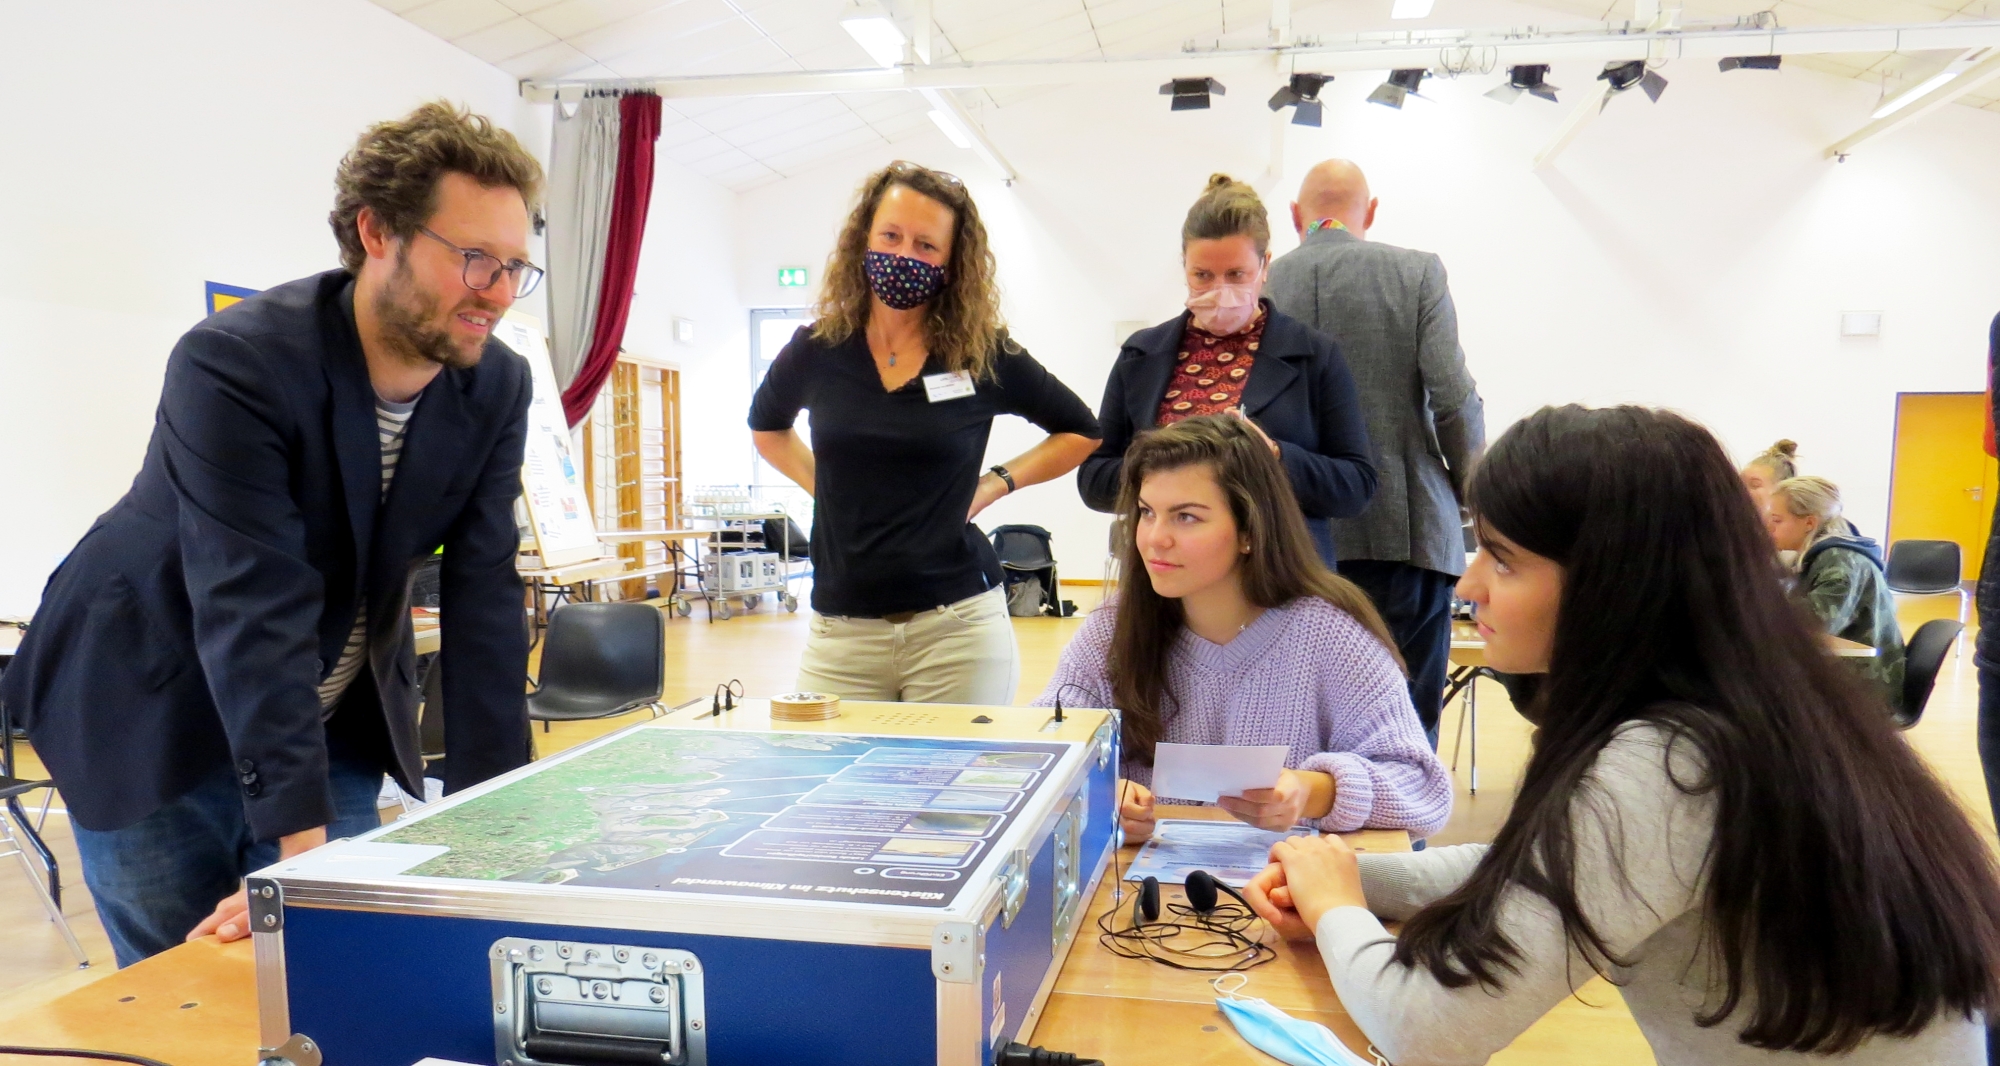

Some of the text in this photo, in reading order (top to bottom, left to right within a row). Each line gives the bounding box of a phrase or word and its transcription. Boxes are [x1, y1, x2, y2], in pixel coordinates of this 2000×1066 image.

[671, 877, 945, 900] Küstenschutz im Klimawandel
